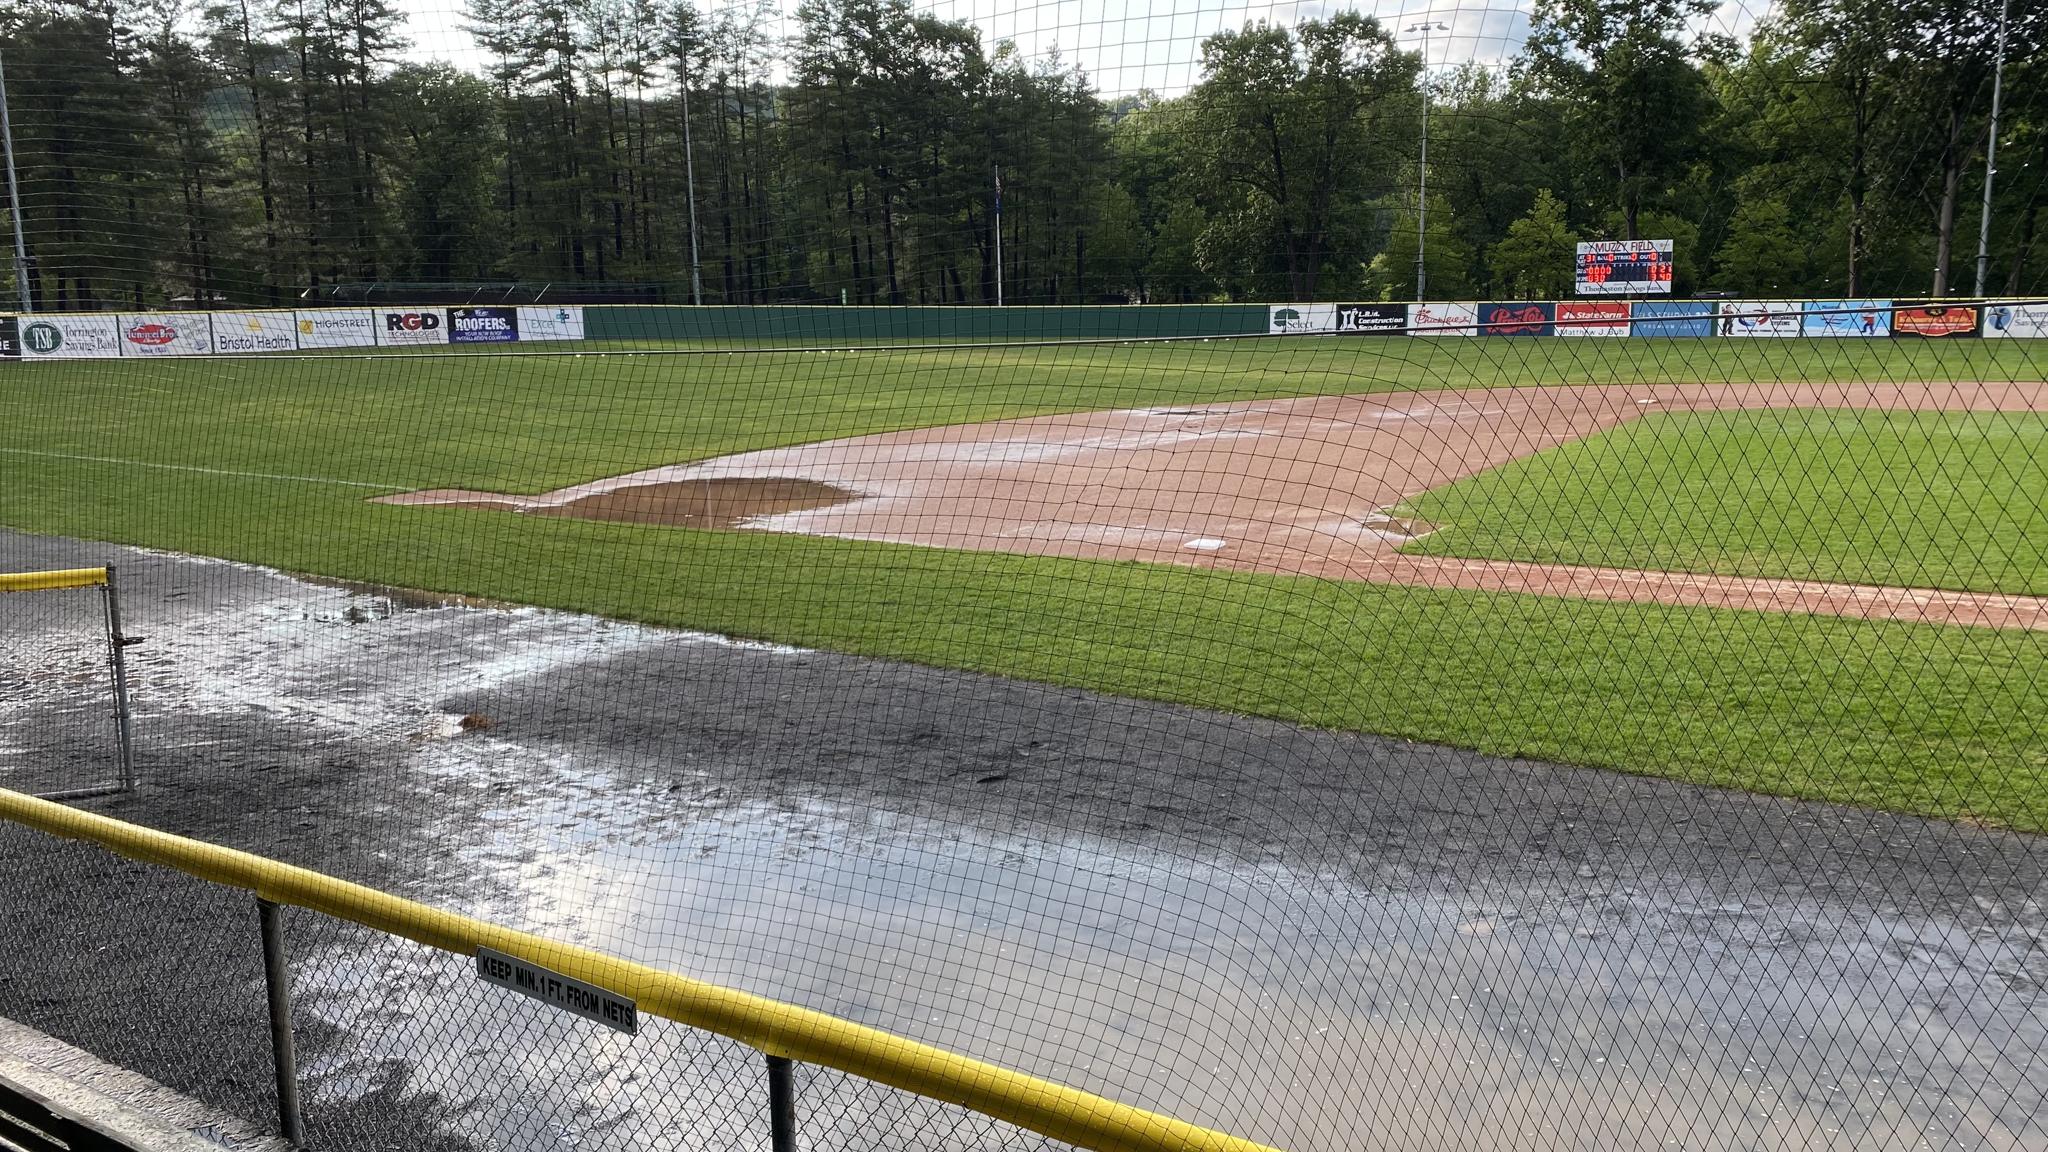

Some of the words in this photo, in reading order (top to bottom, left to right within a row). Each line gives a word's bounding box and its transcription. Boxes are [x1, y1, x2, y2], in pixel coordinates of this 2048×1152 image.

[1595, 242, 1628, 252] MUZZY
[1630, 241, 1654, 251] FIELD
[453, 309, 466, 318] THE
[315, 318, 370, 328] HIGHSTREET
[386, 313, 440, 331] RGD
[455, 317, 506, 331] ROOFERS
[32, 327, 53, 349] TSB
[64, 326, 108, 339] Torrington
[65, 340, 97, 353] Savings
[98, 338, 118, 350] Bank
[220, 336, 254, 350] Bristol
[257, 334, 291, 349] Health
[482, 955, 512, 982] KEEP
[515, 966, 539, 993] MIN.
[540, 975, 546, 995] 1
[548, 978, 565, 1003] FT.
[566, 985, 600, 1015] FROM
[602, 998, 633, 1027] NETS
